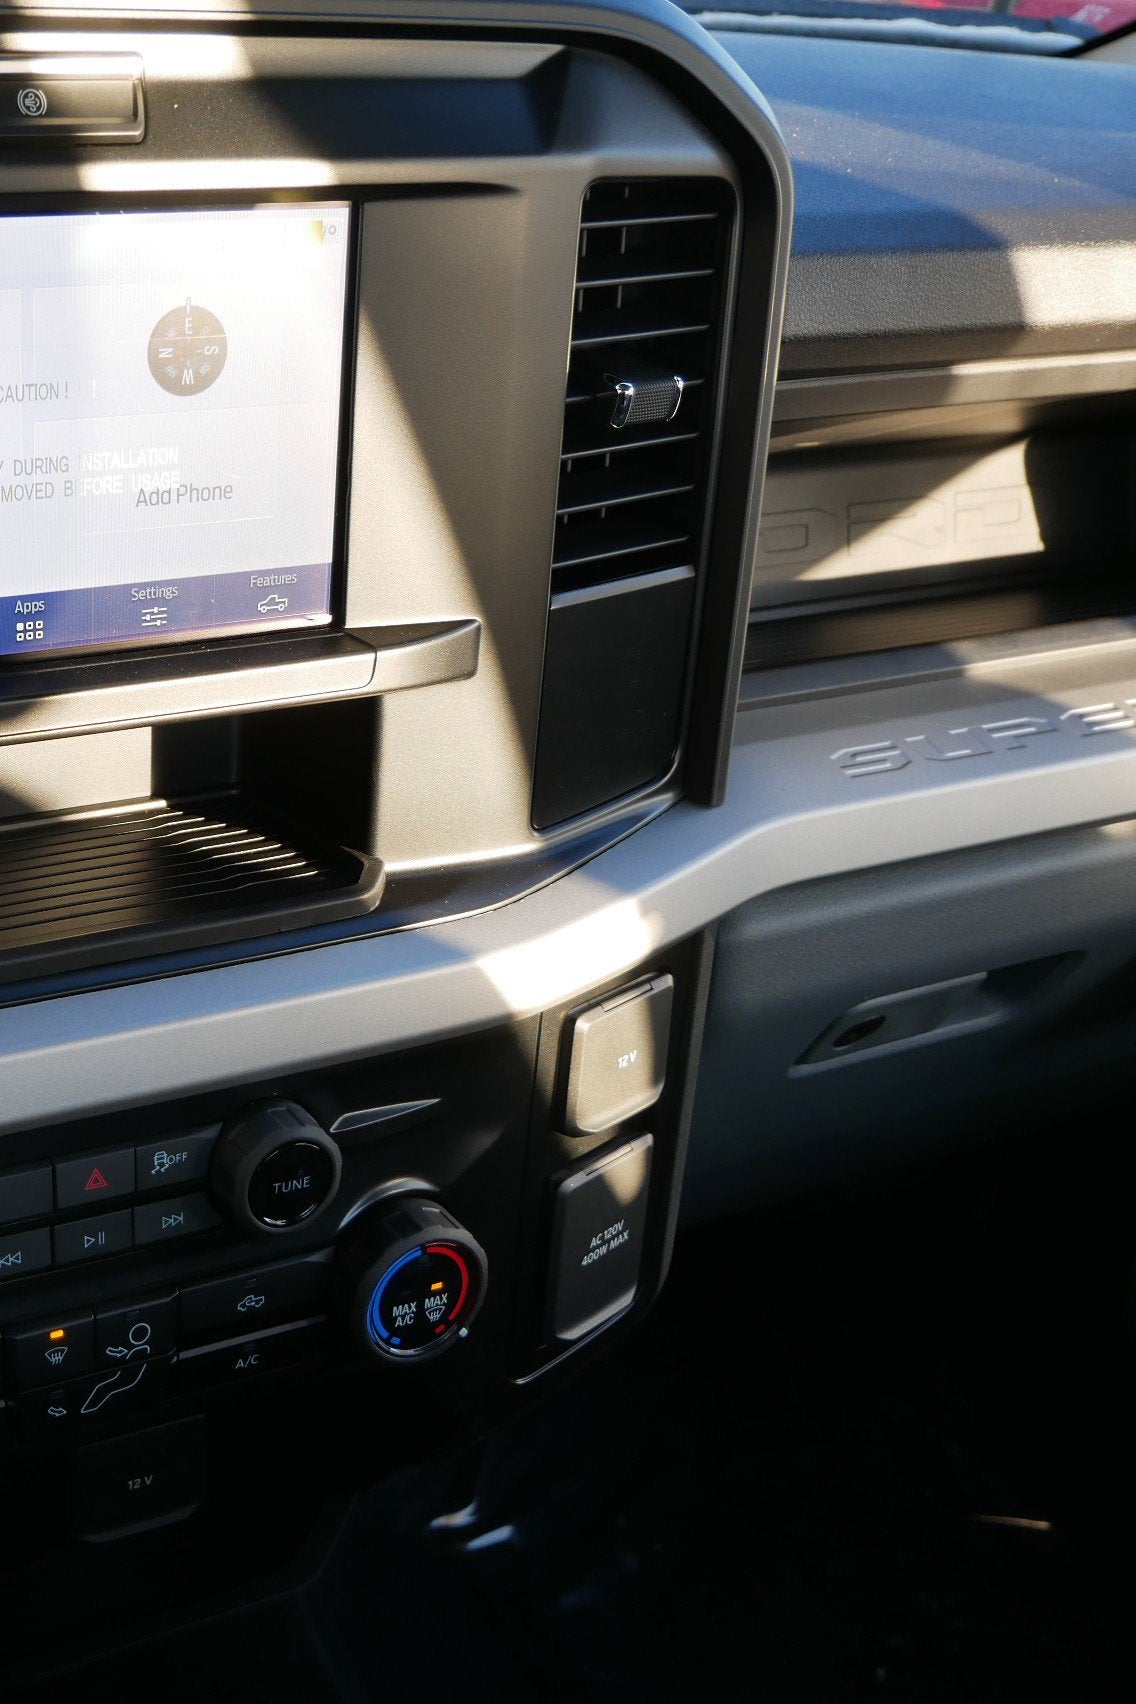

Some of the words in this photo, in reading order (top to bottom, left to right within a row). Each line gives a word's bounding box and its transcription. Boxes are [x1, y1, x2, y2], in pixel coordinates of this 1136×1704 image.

[185, 317, 193, 334] E
[13, 456, 70, 477] DURING
[131, 471, 180, 493] USAGE
[135, 486, 172, 508] Add
[176, 483, 233, 504] Phone
[250, 572, 297, 588] Features
[131, 584, 179, 600] Settings
[14, 599, 45, 614] Apps
[829, 698, 1136, 779] SUPE
[167, 1152, 188, 1165] OFF
[273, 1176, 311, 1195] TUNE
[589, 1232, 603, 1249] AC
[604, 1219, 625, 1240] 120V
[581, 1243, 608, 1266] 400W
[609, 1230, 630, 1250] MAX
[392, 1301, 417, 1317] MAX
[424, 1292, 448, 1309] MAX
[394, 1313, 414, 1328] A/C
[235, 1354, 260, 1370] A/C
